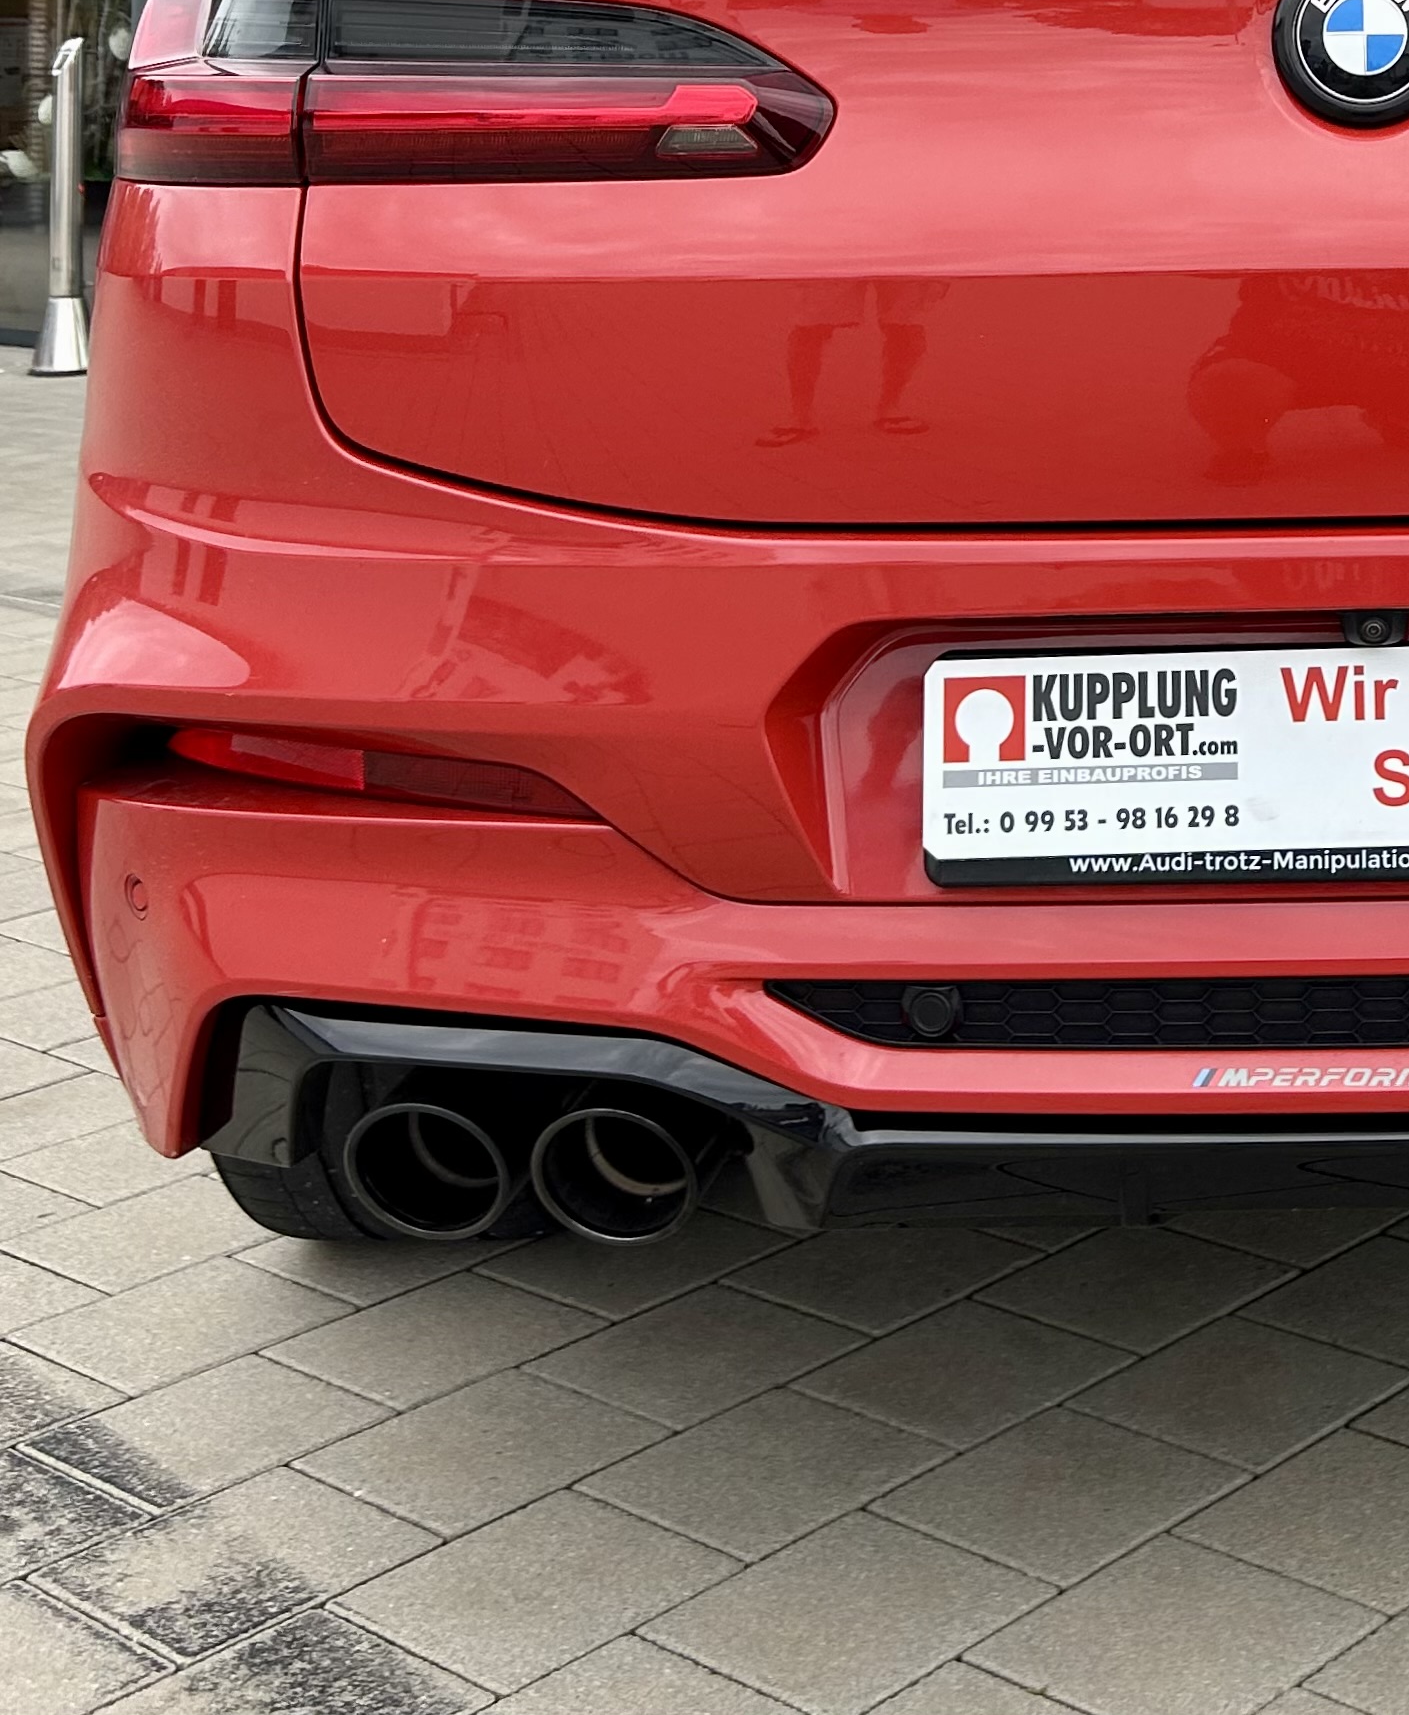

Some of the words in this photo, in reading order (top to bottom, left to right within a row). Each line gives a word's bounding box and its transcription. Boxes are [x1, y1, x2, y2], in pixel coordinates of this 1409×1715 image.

[1032, 668, 1238, 722] KUPPLUNG
[1280, 664, 1399, 723] Wir
[1032, 723, 1238, 760] -VOR-ORT.com
[978, 770, 1031, 785] IHRE
[1038, 766, 1202, 784] EINBAUPROFIS
[943, 813, 990, 834] Tel.:
[1000, 811, 1015, 833] 0
[1025, 810, 1055, 832] 99
[1065, 809, 1089, 831] 53
[1116, 807, 1147, 830] 98
[1156, 806, 1179, 829] 16
[1188, 805, 1215, 828] 29
[1224, 804, 1240, 827] 8
